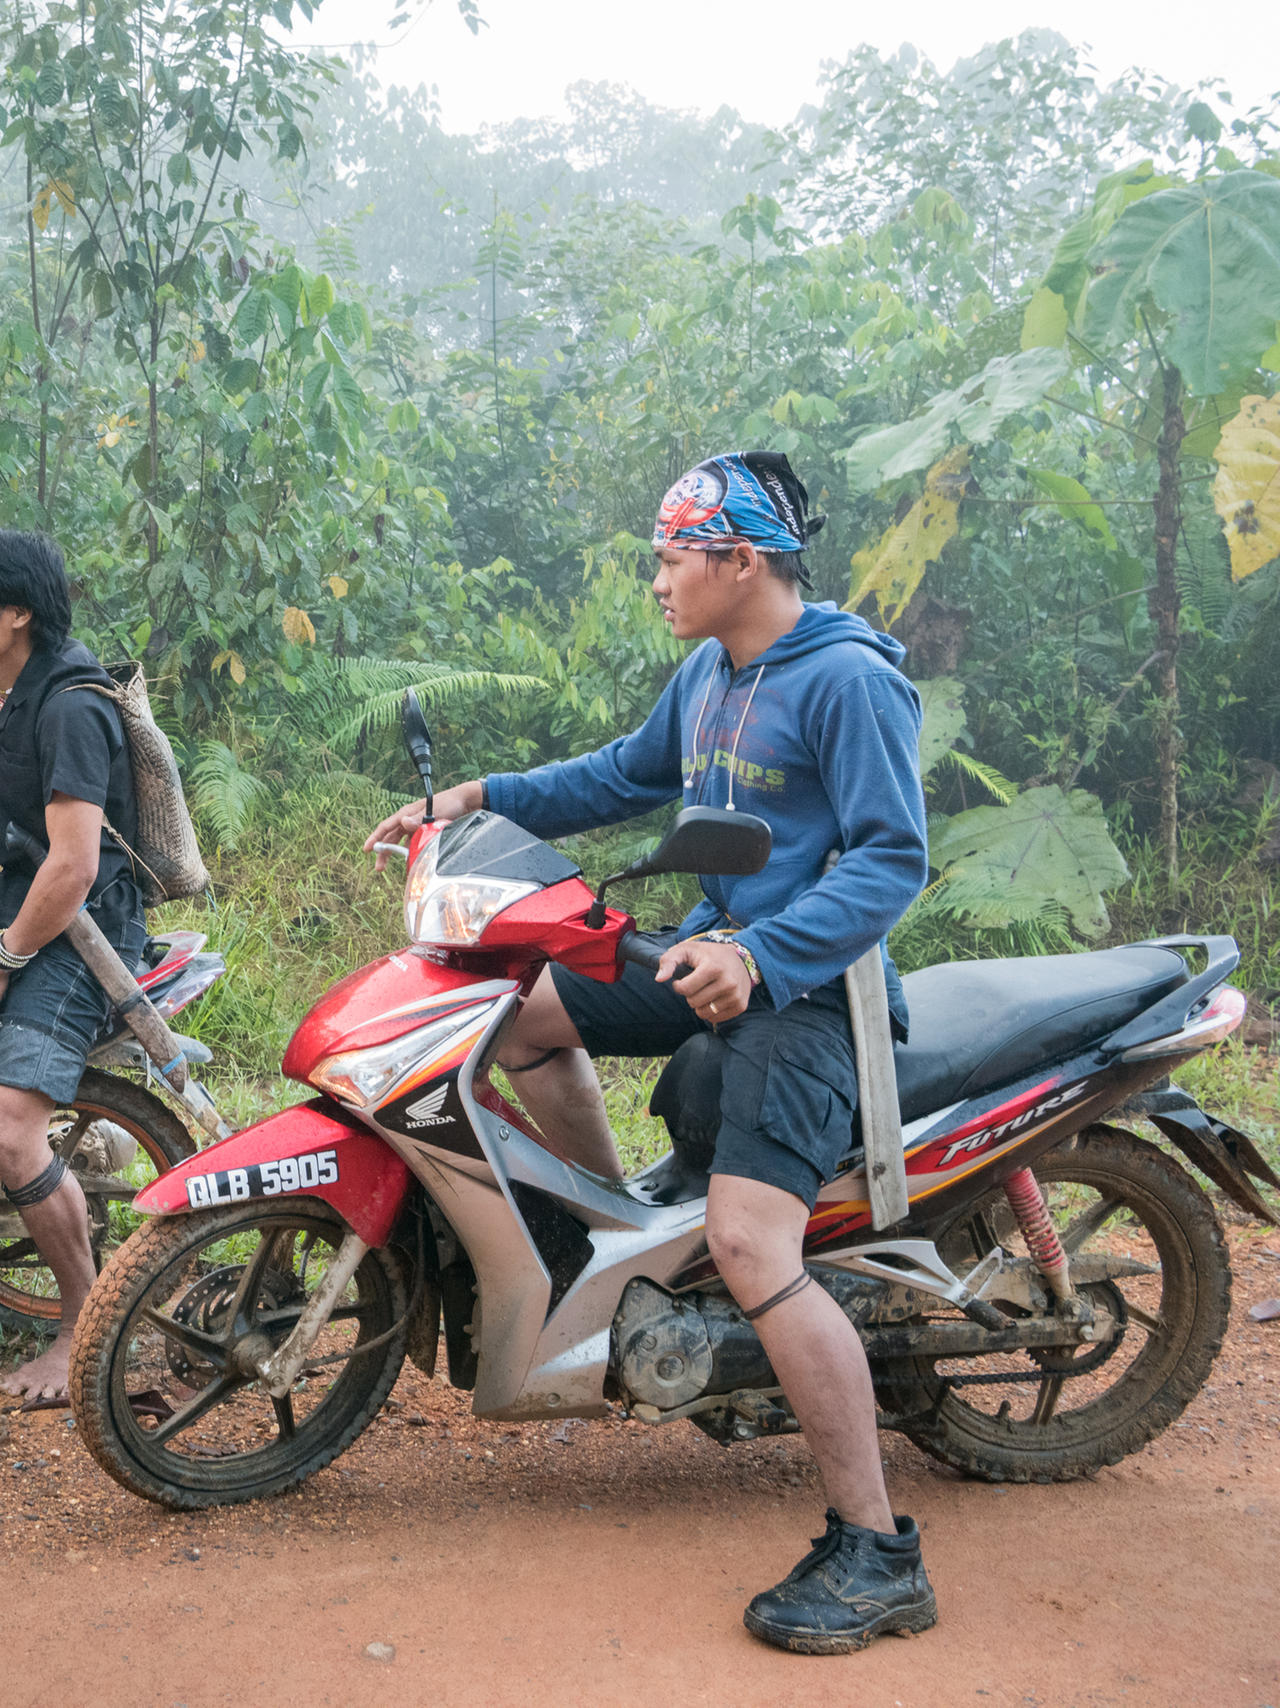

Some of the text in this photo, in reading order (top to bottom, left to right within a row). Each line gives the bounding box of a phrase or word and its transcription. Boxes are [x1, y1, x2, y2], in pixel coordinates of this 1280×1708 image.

[714, 749, 785, 785] CHIPS
[406, 1115, 456, 1129] HONDA
[938, 1080, 1090, 1166] FUTURE
[188, 1149, 339, 1208] QLB 5905
